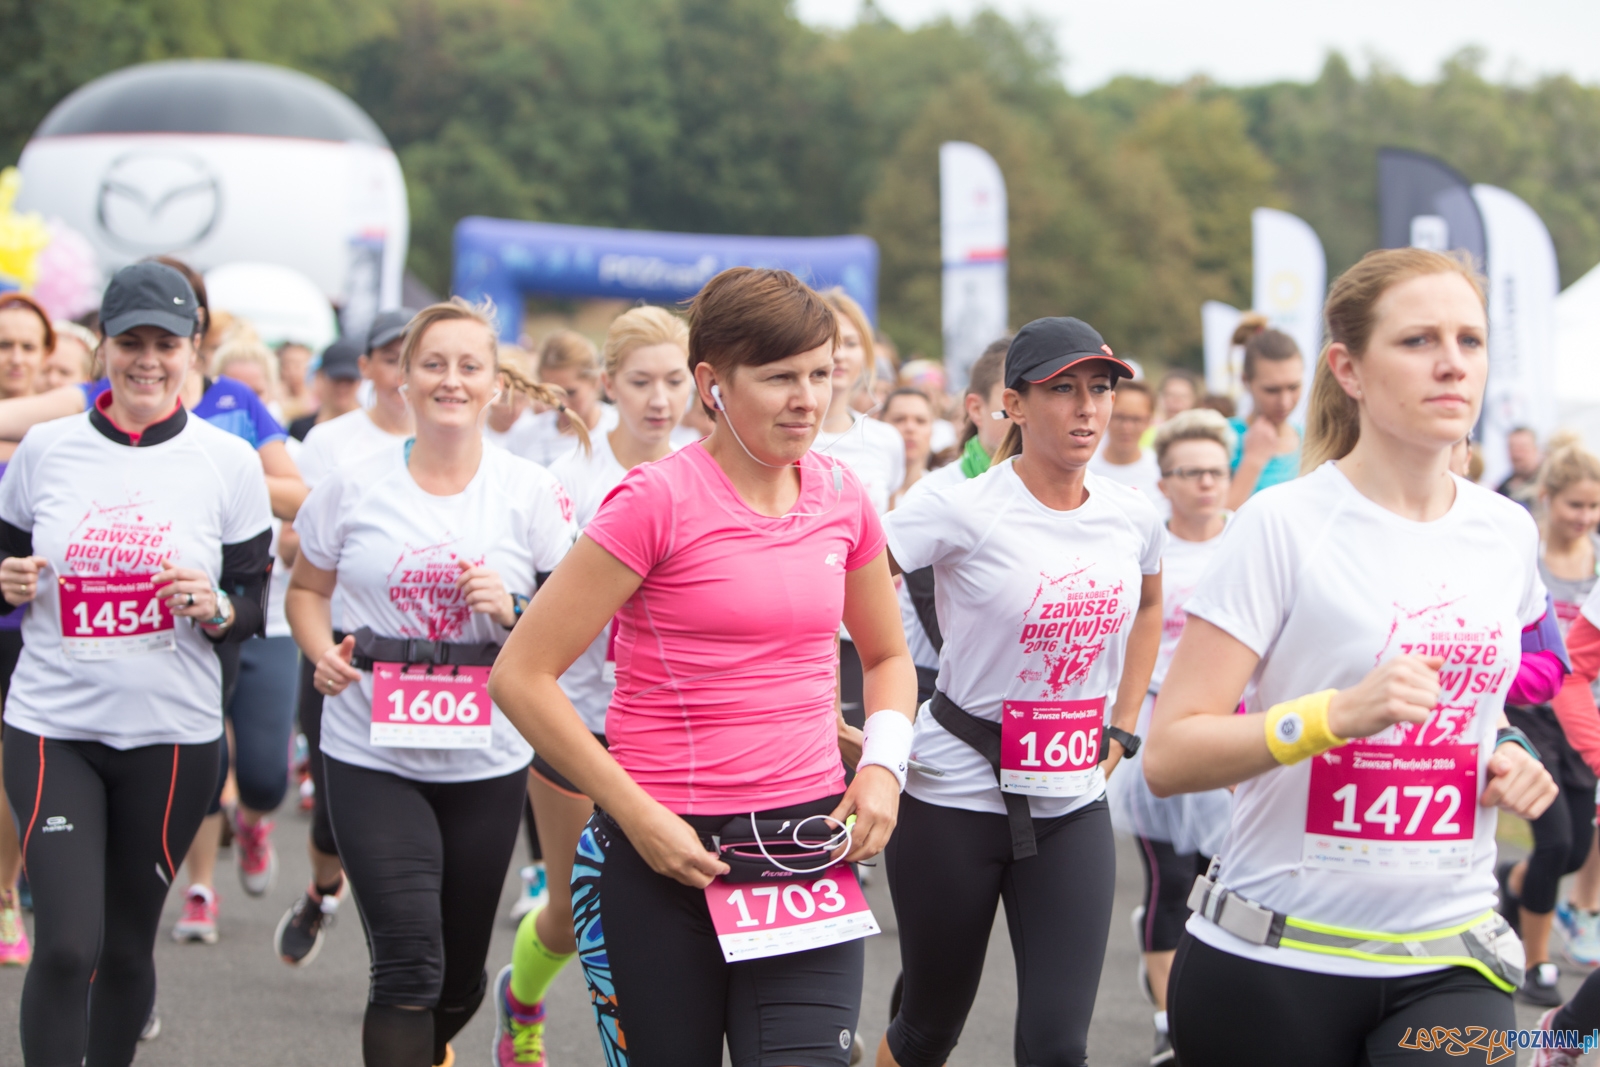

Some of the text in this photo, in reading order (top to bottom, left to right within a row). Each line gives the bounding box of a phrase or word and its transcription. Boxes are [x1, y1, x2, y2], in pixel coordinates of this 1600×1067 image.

[83, 527, 163, 548] zawsze
[69, 560, 101, 573] 2016
[1067, 589, 1111, 601] BIEG KOBIET
[72, 597, 164, 635] 1454
[1039, 597, 1119, 620] zawsze
[1023, 640, 1059, 654] 2016
[387, 688, 480, 724] 1606
[1032, 711, 1061, 720] Zawsze
[1019, 727, 1098, 767] 1605
[1352, 756, 1392, 770] Zawsze
[1332, 783, 1462, 836] 1472
[726, 878, 847, 928] 1703
